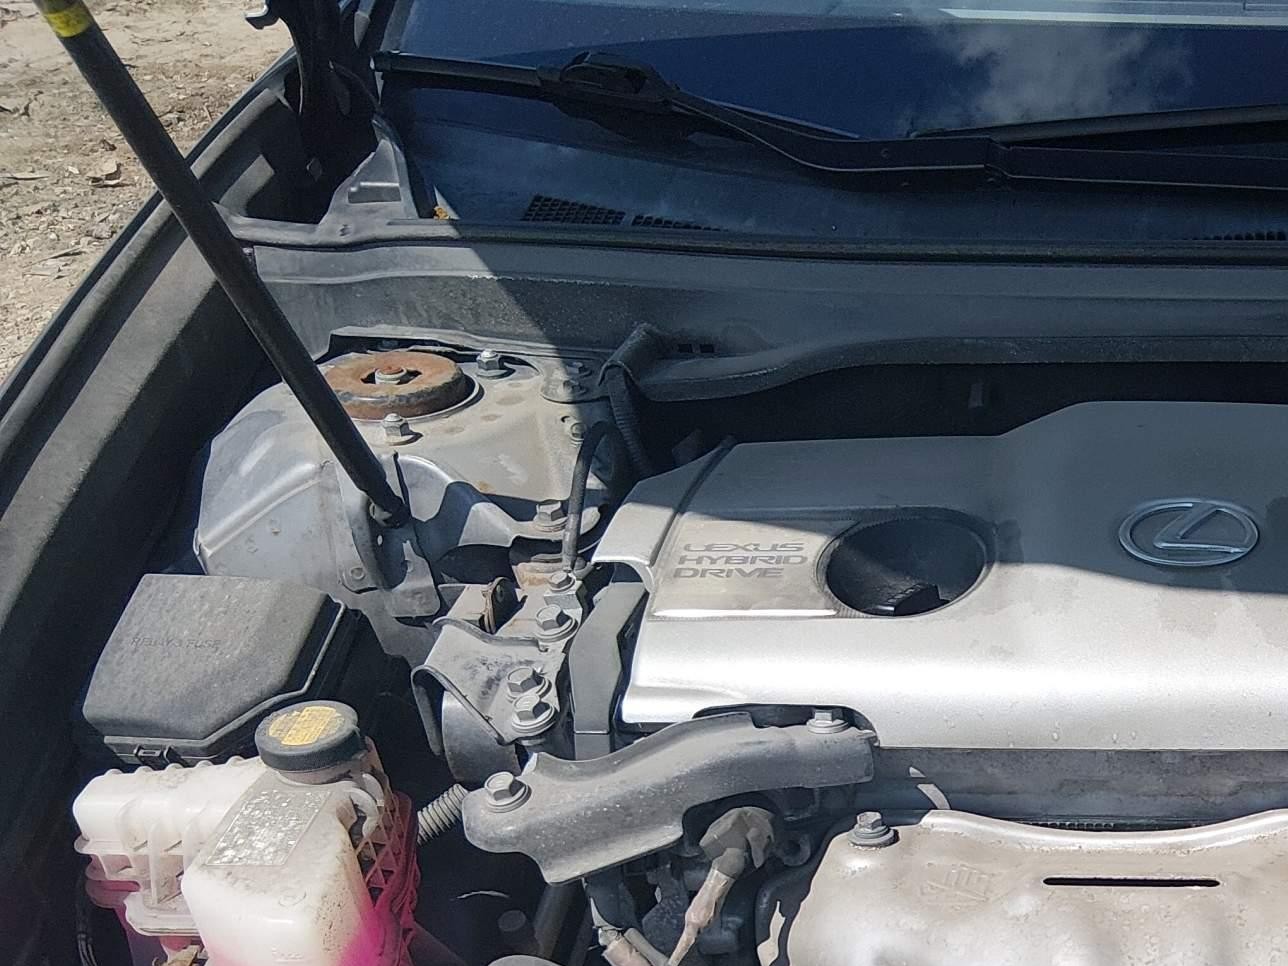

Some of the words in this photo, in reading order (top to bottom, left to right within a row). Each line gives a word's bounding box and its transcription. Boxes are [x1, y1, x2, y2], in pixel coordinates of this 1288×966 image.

[683, 542, 805, 552] LEXUS
[677, 554, 808, 565] HYBRID
[673, 567, 785, 578] DRIVE
